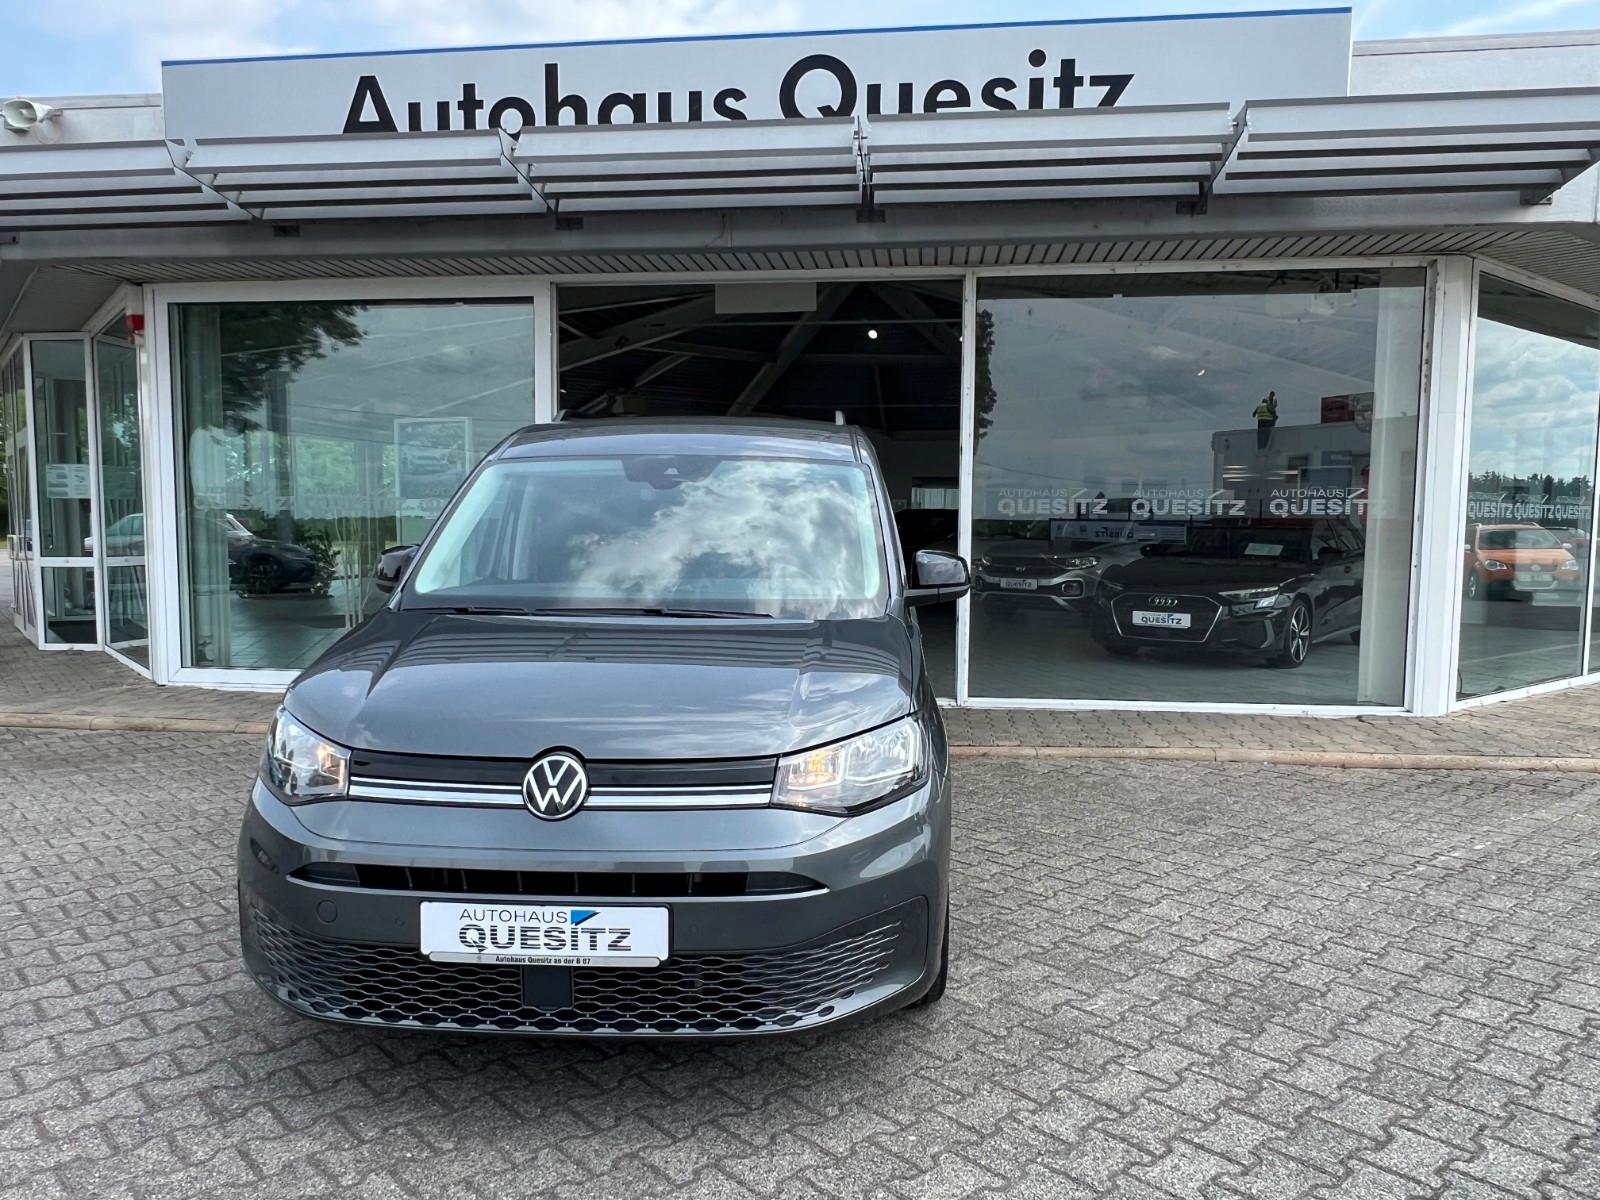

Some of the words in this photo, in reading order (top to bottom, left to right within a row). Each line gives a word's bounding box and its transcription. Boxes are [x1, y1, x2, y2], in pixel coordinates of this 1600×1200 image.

[342, 63, 748, 136] Autohaus
[779, 49, 1135, 120] Quesitz
[1133, 489, 1204, 498] AUTOHAUS
[1270, 488, 1345, 498] AUTOHAUS
[998, 498, 1108, 517] QUESITZ
[1131, 498, 1246, 518] QUESITZ
[1468, 501, 1513, 519] QUESITZ
[1514, 502, 1554, 520] QUESITZ
[1141, 615, 1182, 625] QUESITZ
[459, 908, 568, 924] AUTOHAUS
[459, 923, 632, 954] QUESITZ
[495, 955, 526, 963] Autohaus
